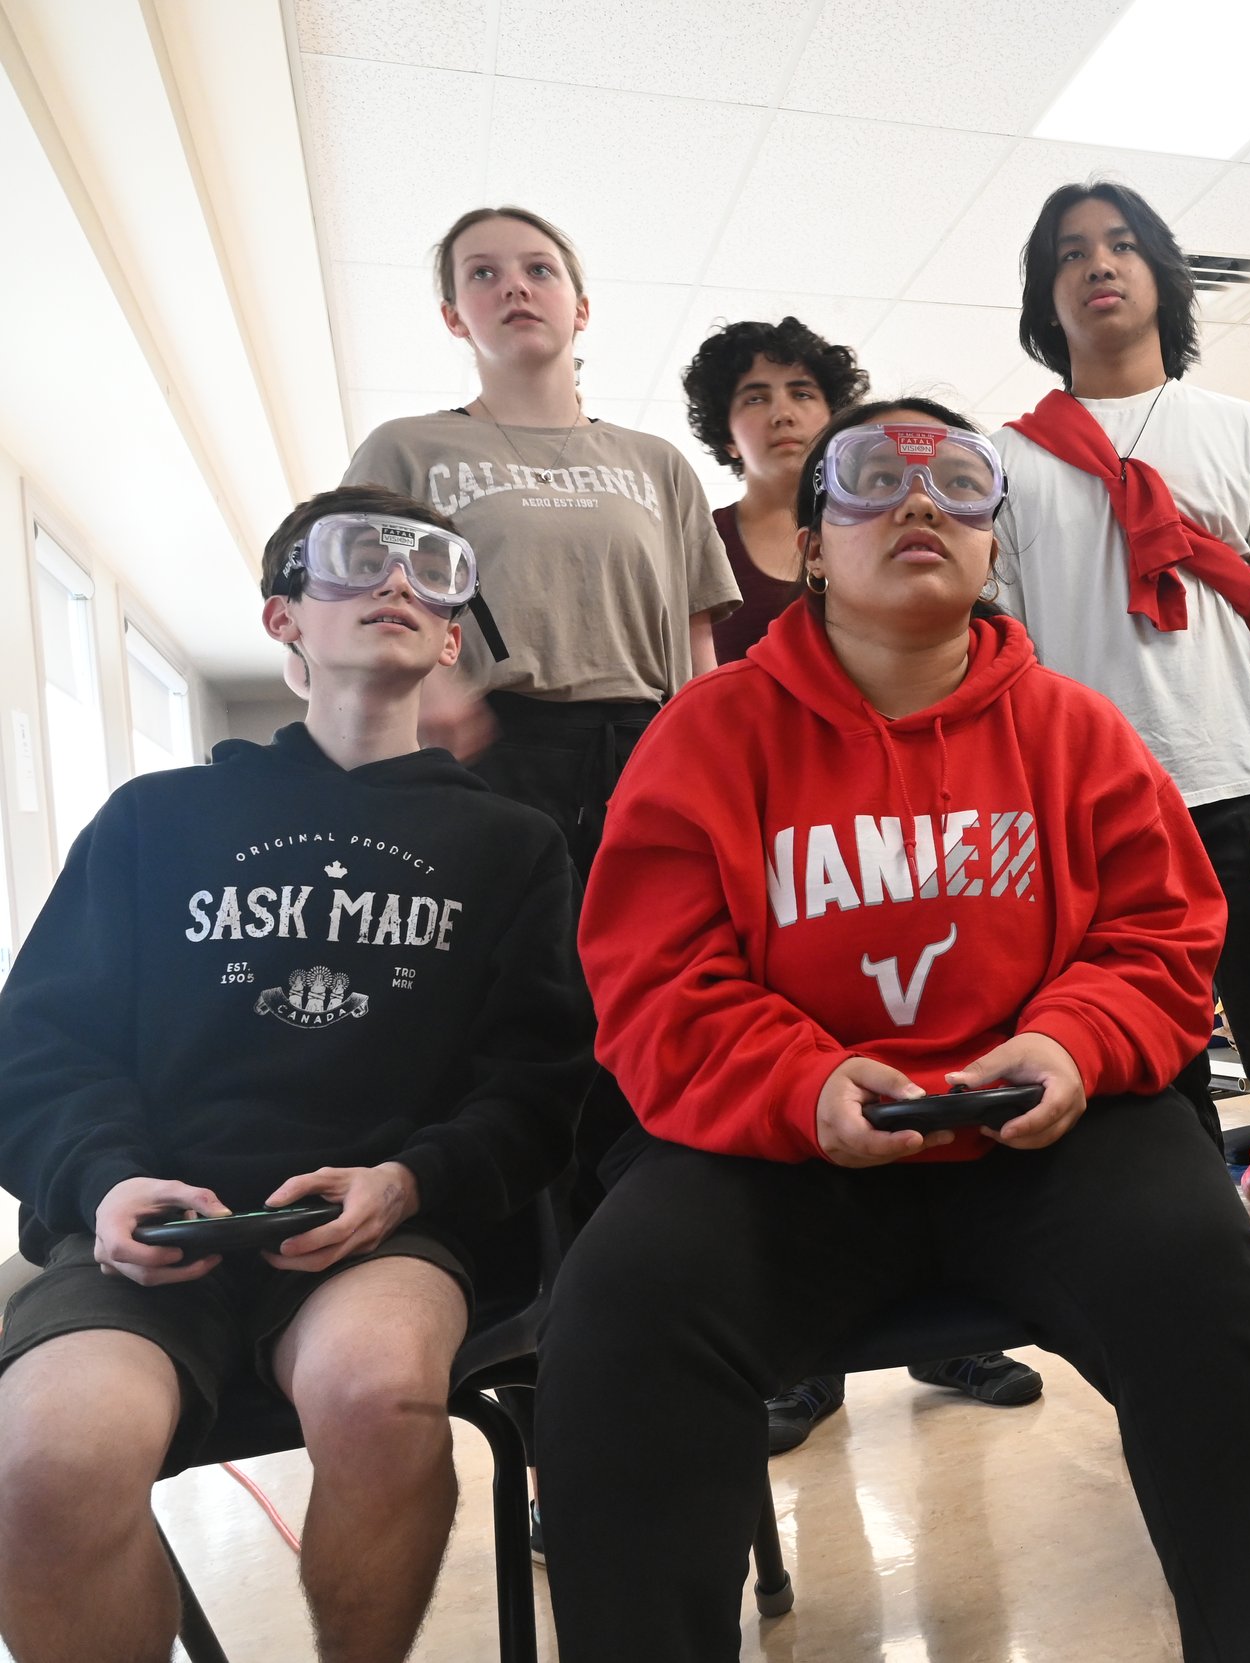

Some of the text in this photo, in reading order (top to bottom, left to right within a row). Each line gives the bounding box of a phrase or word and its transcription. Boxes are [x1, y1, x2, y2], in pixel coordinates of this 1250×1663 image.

[428, 461, 662, 521] CALIFORNIA
[384, 528, 413, 538] FATAL
[384, 535, 413, 545] VISION
[236, 832, 435, 875] ORIGINAL PRODUCT
[766, 809, 1036, 928] VANIER
[185, 885, 463, 951] SASK MADE
[226, 962, 251, 973] EST.
[394, 966, 416, 979] TRD
[220, 972, 255, 985] 1905
[392, 978, 414, 991] MRK
[277, 1003, 347, 1025] CANADA
